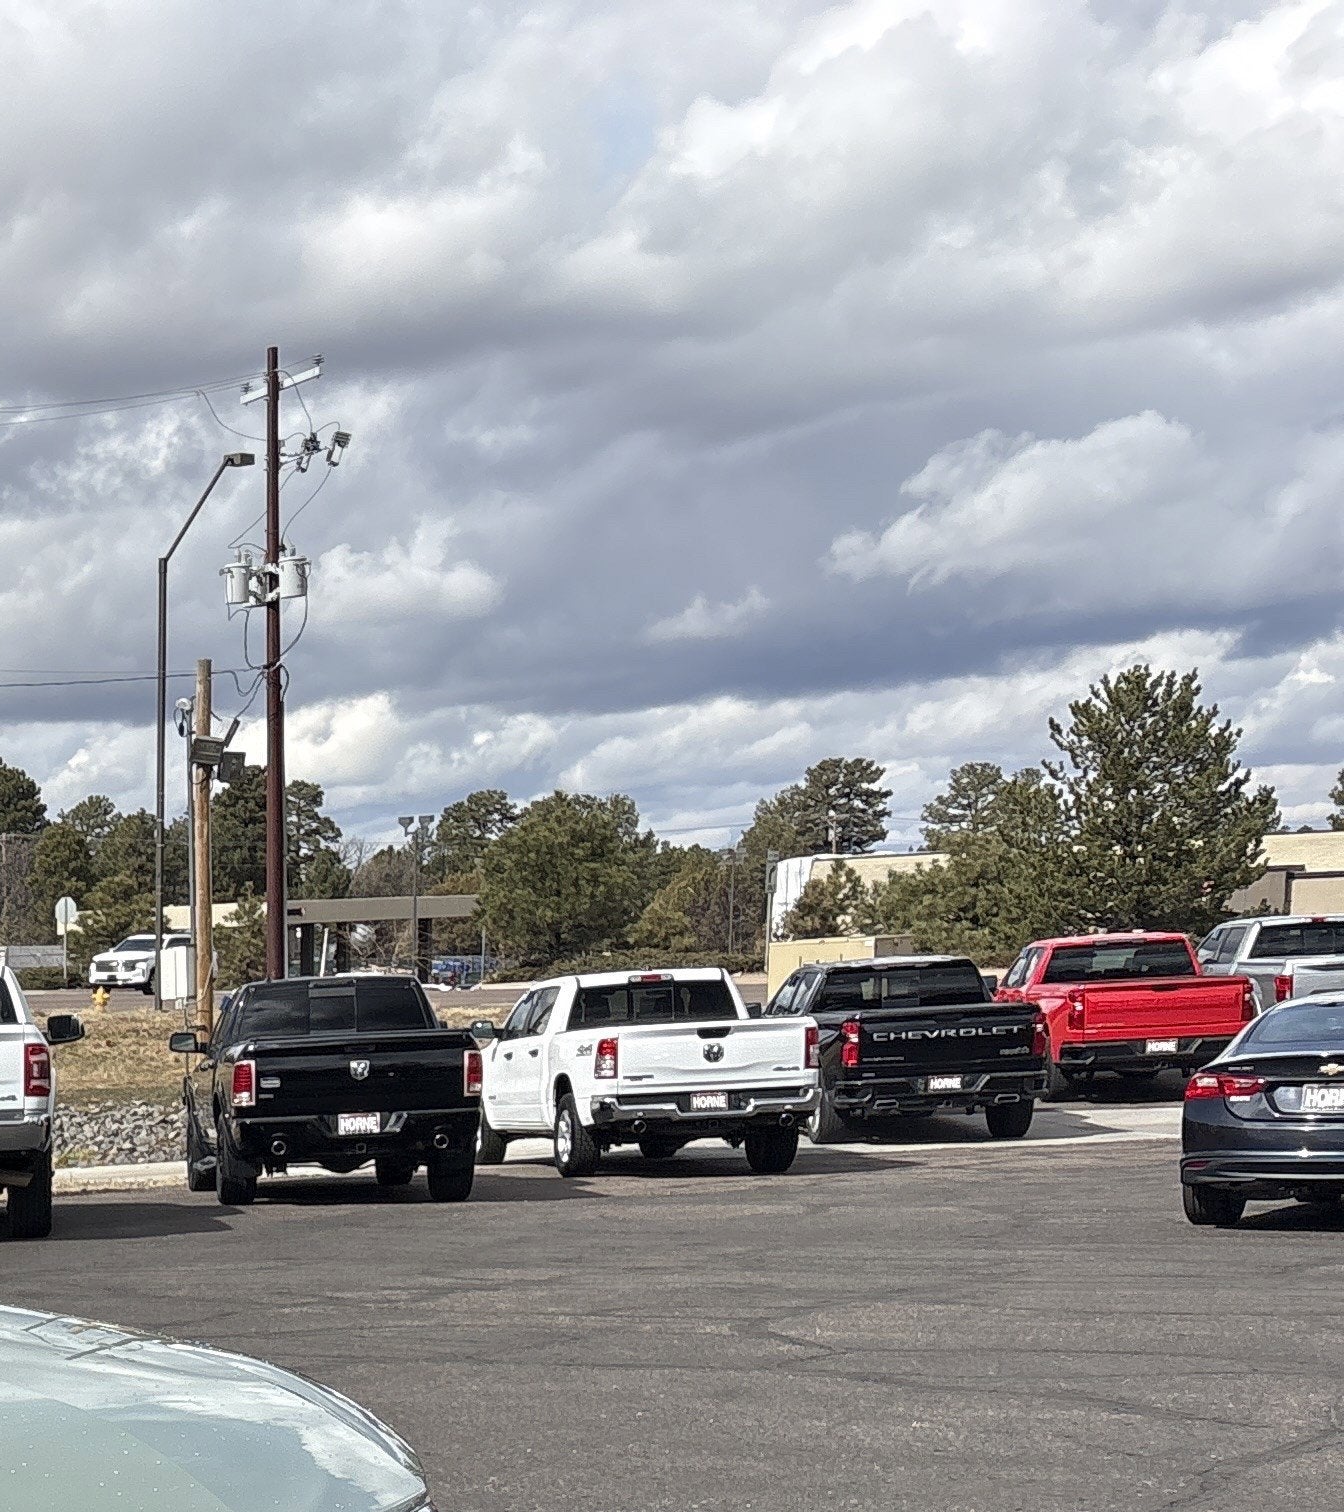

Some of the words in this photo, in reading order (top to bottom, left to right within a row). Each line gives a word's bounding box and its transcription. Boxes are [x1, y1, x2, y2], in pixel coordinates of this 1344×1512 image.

[872, 1025, 1027, 1042] CHEVROLET
[692, 1094, 727, 1109] HORNE
[1304, 1088, 1344, 1107] HOR
[340, 1117, 378, 1133] HORNE
